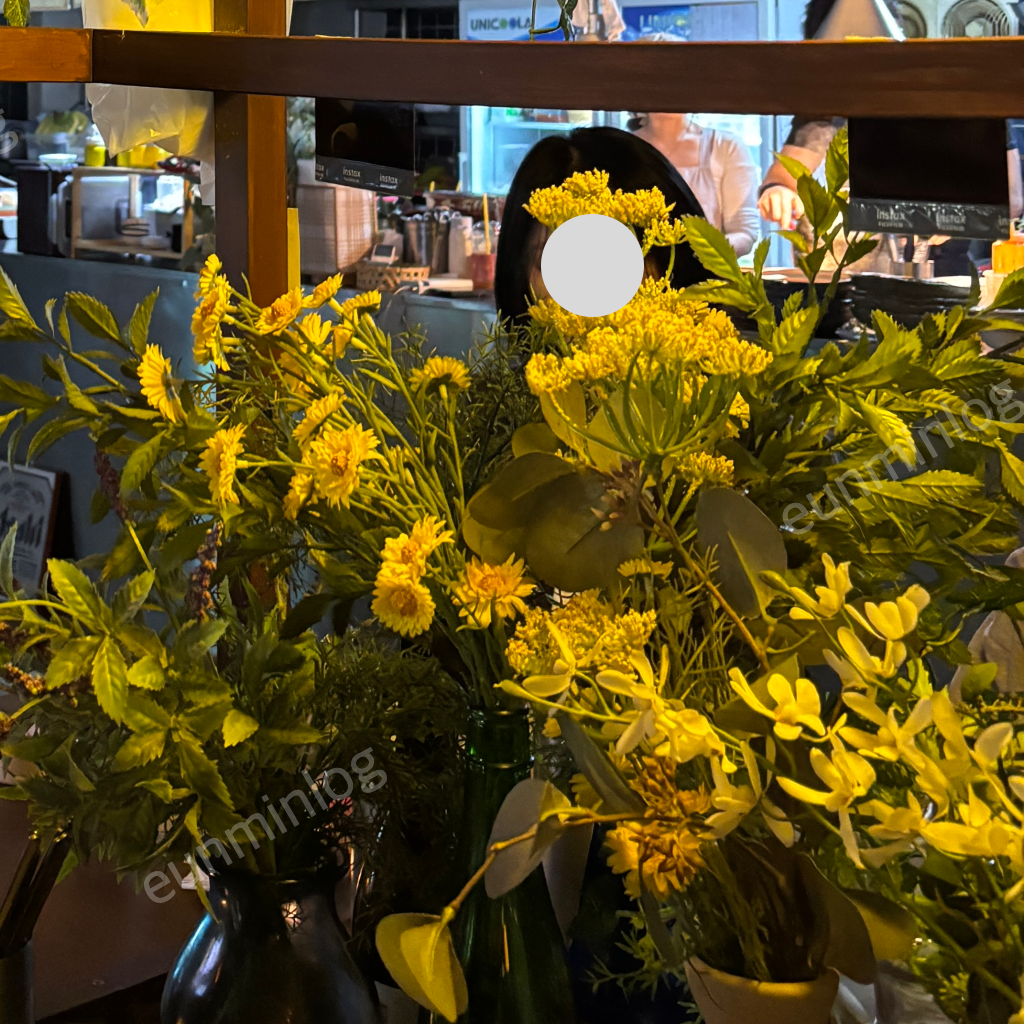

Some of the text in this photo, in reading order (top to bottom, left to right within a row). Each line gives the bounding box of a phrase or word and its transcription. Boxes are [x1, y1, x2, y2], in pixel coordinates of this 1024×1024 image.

[342, 166, 362, 178] instax
[379, 173, 398, 184] instax
[876, 208, 905, 220] instax
[936, 211, 966, 224] instax
